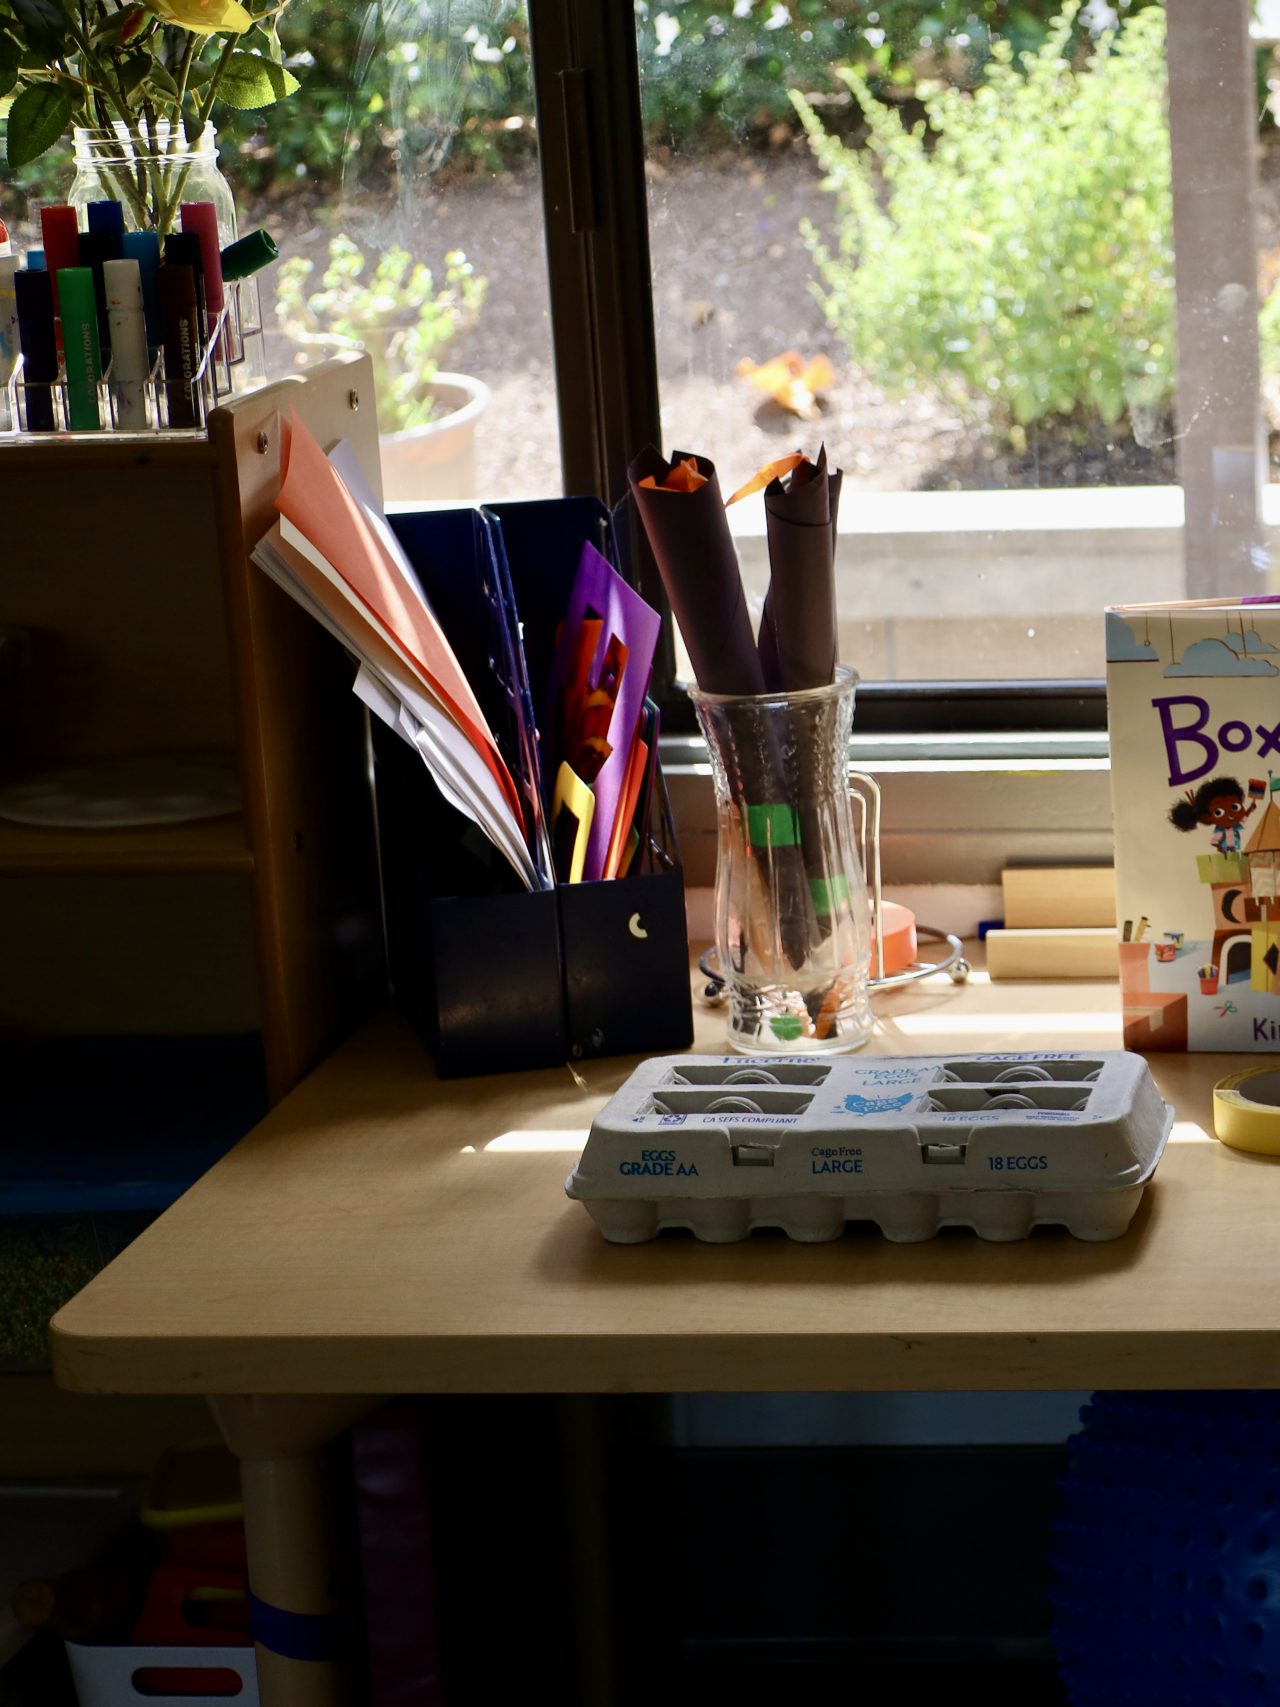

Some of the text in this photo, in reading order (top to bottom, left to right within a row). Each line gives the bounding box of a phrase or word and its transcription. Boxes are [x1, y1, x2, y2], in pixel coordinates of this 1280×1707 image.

[1032, 1053, 1080, 1061] FREE
[874, 1072, 919, 1080] EGGS
[862, 1078, 921, 1086] LARGE
[702, 1116, 717, 1124] CA
[741, 1116, 799, 1125] COMPLIANT
[942, 1114, 1001, 1122] 18 EGGS
[641, 1150, 677, 1162] EGGS
[811, 1147, 862, 1158] Cage Free
[812, 1160, 863, 1174] LARGE
[988, 1156, 1048, 1171] 18 EGGS
[619, 1162, 699, 1177] GRADE AA
